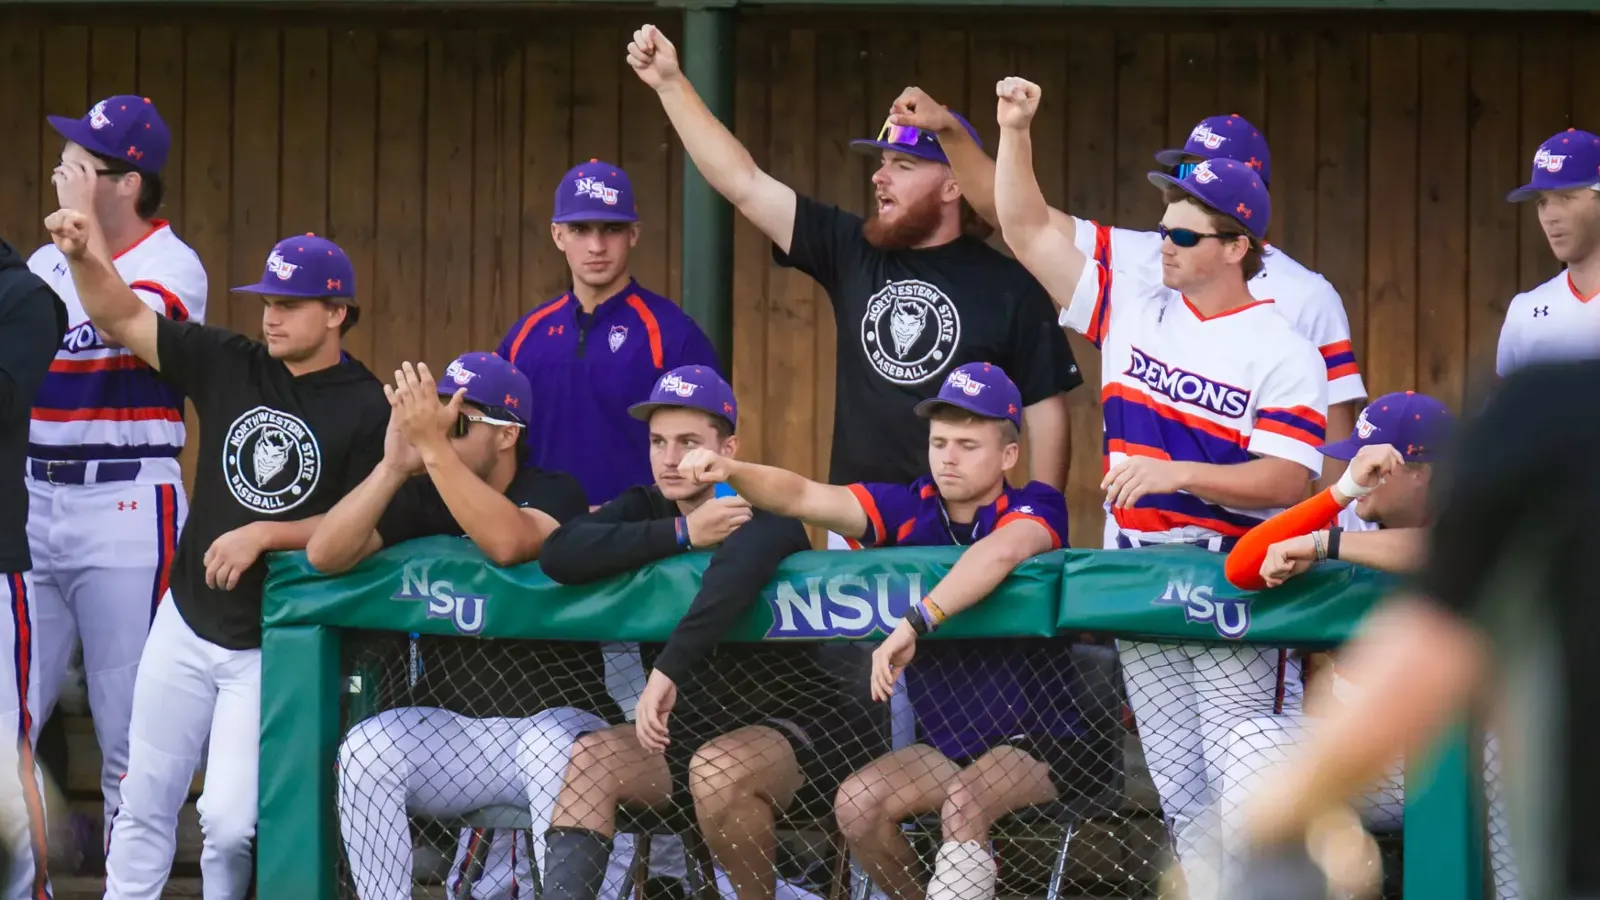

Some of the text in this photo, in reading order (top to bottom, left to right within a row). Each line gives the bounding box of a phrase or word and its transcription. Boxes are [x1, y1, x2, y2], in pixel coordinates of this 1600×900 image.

[575, 177, 619, 205] NSU
[939, 304, 954, 343] STATE
[872, 350, 928, 380] BASEBALL
[945, 370, 986, 397] NSU
[1129, 348, 1248, 417] DEMONS
[658, 373, 698, 398] NSU
[230, 411, 315, 481] NORTHWESTERN STATE
[231, 474, 285, 509] BASEBALL
[401, 563, 485, 631] NSU
[774, 572, 922, 631] NSU
[1161, 577, 1247, 635] NSU
